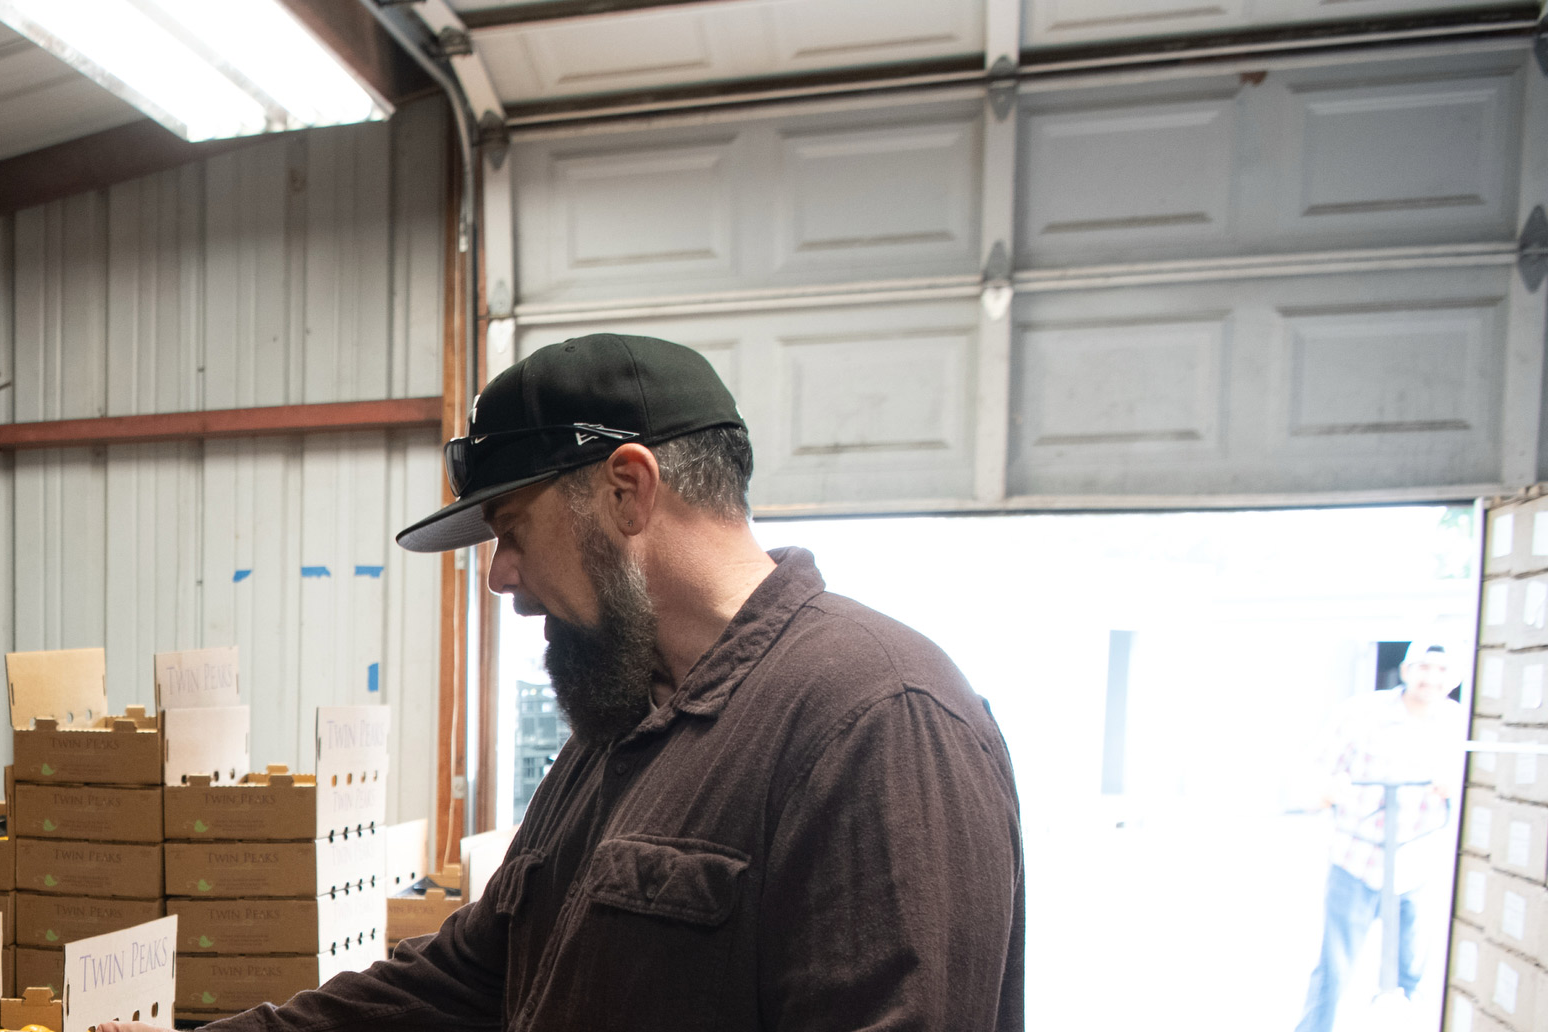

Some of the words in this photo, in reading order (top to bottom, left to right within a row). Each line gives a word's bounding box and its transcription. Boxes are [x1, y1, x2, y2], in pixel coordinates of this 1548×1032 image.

[166, 665, 199, 695] TWIN
[204, 663, 232, 691] PEAKS
[51, 736, 81, 748] TWIN
[86, 737, 120, 749] PEAKS
[53, 793, 84, 805] TWIN
[88, 794, 122, 807] PEAKS
[204, 792, 237, 804] TWIN
[241, 793, 276, 805] PEAKS
[53, 848, 84, 860] TWIN
[88, 851, 122, 863] PEAKS
[208, 852, 239, 863] TWIN
[243, 852, 280, 863] PEAKS
[53, 903, 86, 916] TWIN
[89, 905, 123, 918] PEAKS
[207, 908, 240, 920] TWIN
[245, 908, 281, 920] PEAKS
[79, 951, 125, 993] TWIN
[130, 935, 169, 978] PEAKS
[211, 964, 242, 976] TWIN
[246, 965, 282, 977] PEAKS
